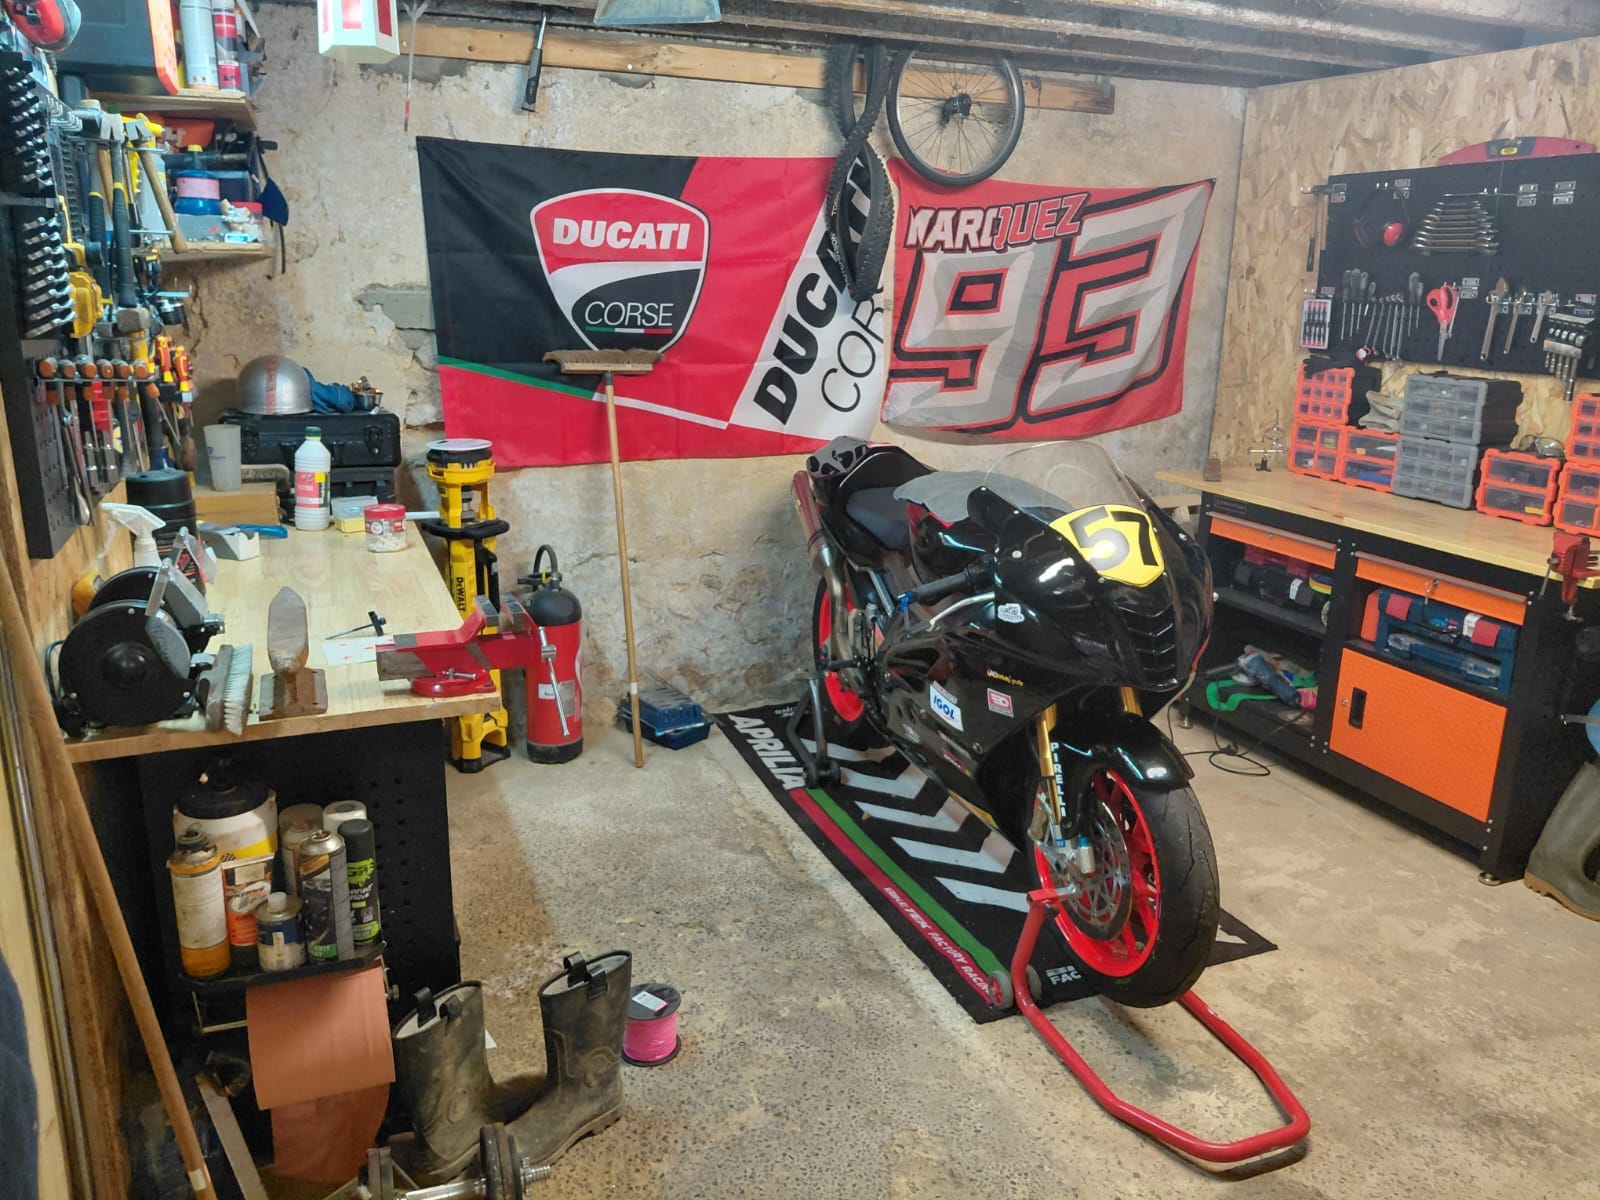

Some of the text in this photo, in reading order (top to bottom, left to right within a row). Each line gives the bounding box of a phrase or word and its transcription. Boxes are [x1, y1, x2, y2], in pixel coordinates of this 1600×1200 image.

[552, 218, 692, 250] DUCATI
[904, 192, 1089, 253] MARQUEZ
[584, 300, 674, 328] CORSE
[881, 183, 1208, 428] 93
[821, 285, 884, 413] COR
[1068, 506, 1159, 572] 57
[933, 695, 957, 721] IGOL
[727, 714, 806, 791] APRILIA
[1050, 742, 1067, 817] PIRELLI
[928, 931, 969, 966] FACTORY
[961, 964, 990, 994] RACIN
